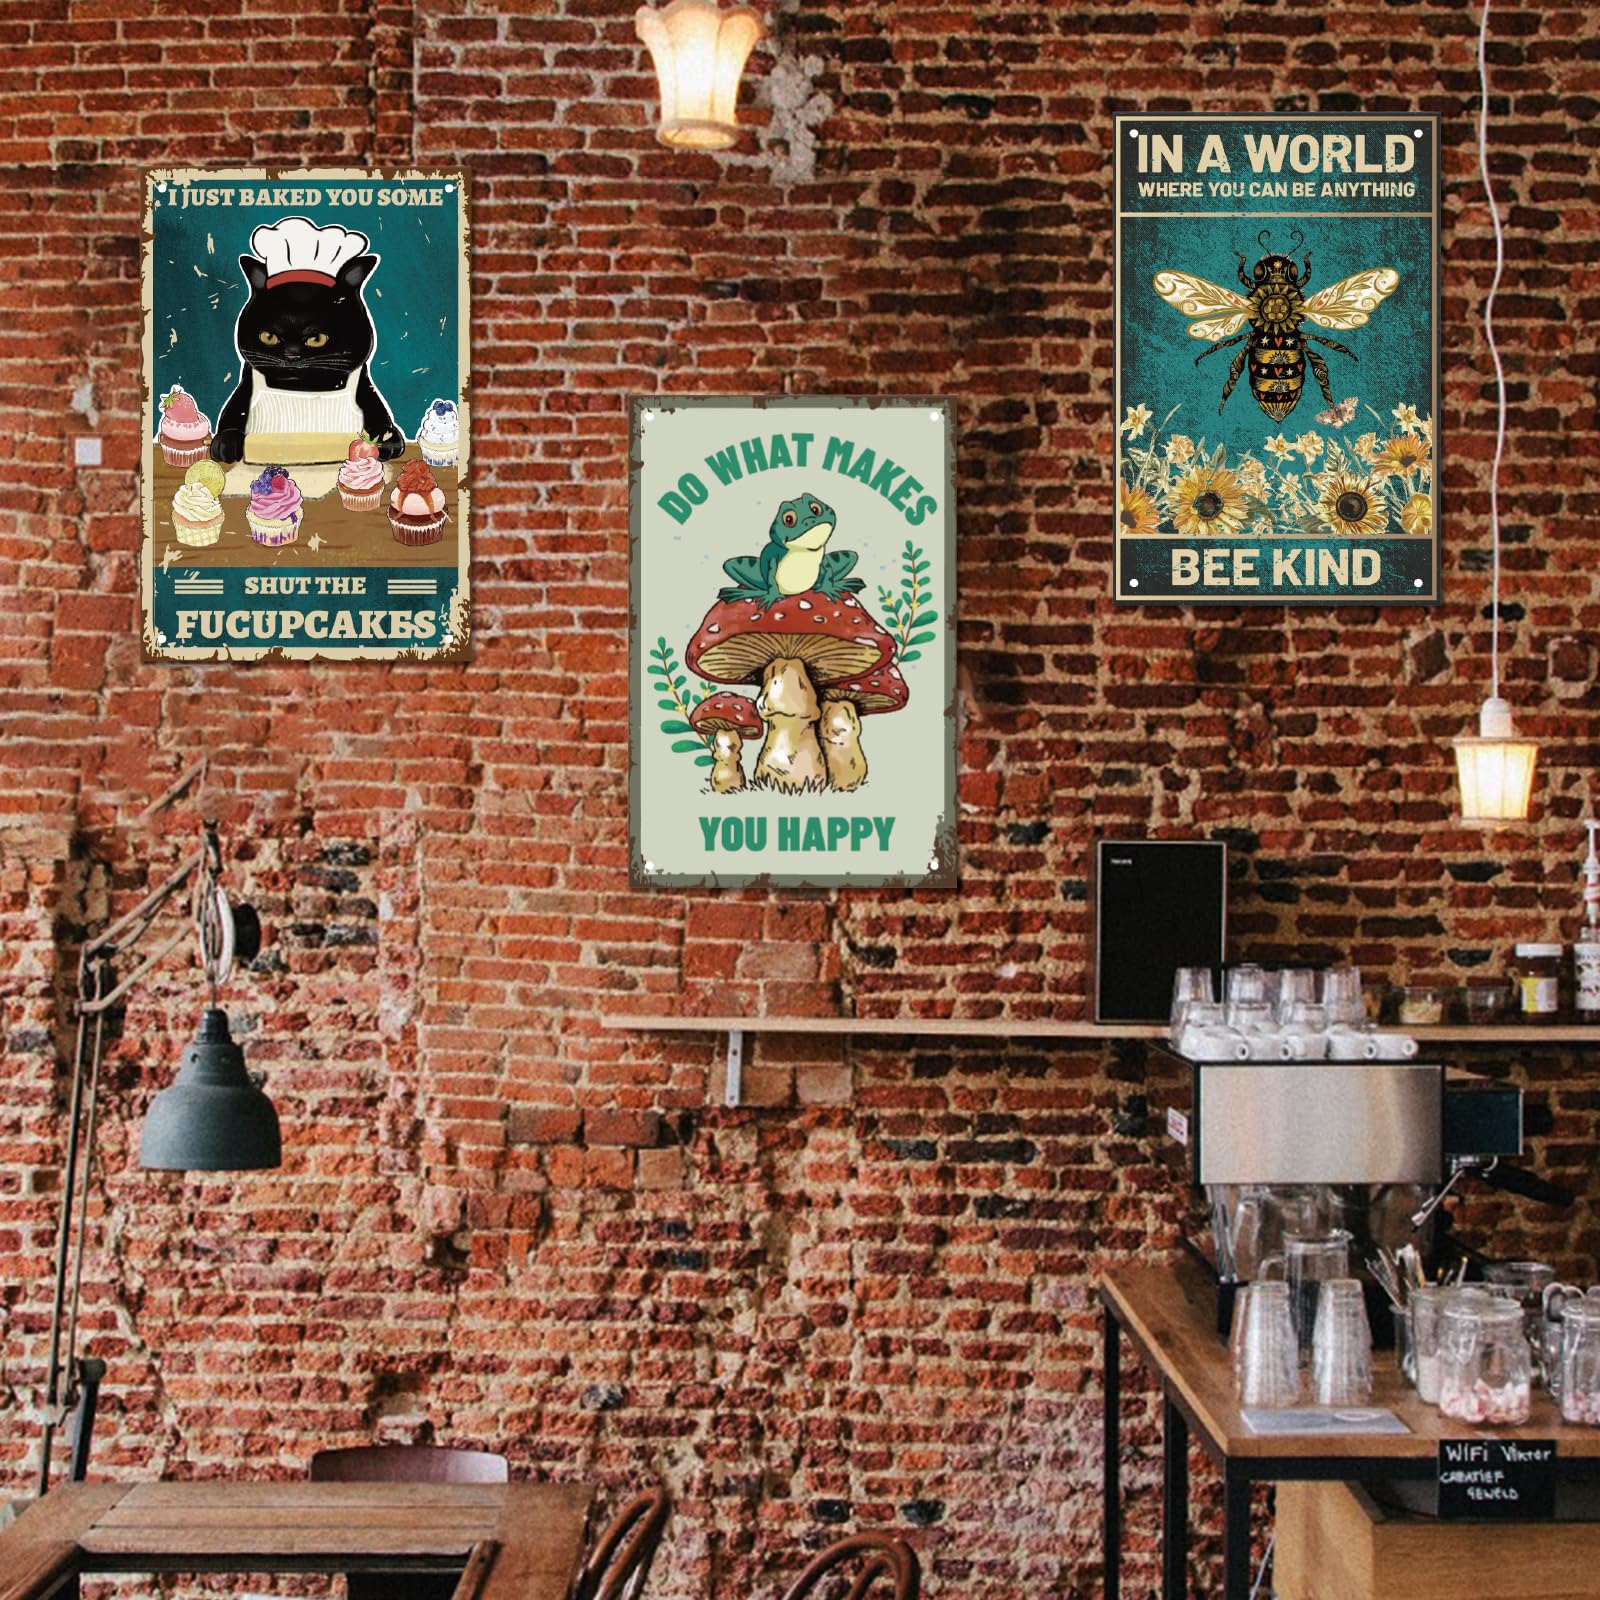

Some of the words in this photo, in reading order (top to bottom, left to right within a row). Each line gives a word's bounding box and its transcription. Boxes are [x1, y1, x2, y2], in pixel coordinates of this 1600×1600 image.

[1138, 134, 1183, 173] IN
[1196, 134, 1232, 173] A
[1244, 134, 1415, 174] WORLD
[168, 188, 177, 206] I
[181, 188, 234, 209] JUST
[239, 188, 321, 206] BAKED
[325, 188, 374, 206] YOU
[377, 187, 443, 206] SOME
[1138, 182, 1204, 197] WHERE
[1208, 182, 1245, 197] YOU
[1249, 182, 1288, 197] CAN
[1292, 182, 1316, 197] BE
[1320, 182, 1416, 198] ANYTHING
[657, 472, 709, 525] DO
[704, 432, 814, 487] WHAT
[822, 436, 937, 526] MAKES
[1171, 548, 1260, 586] BEE
[1272, 548, 1382, 586] KIND
[244, 576, 315, 595] SHUT
[316, 576, 366, 595] THE
[175, 610, 436, 640] FUCUPCAKES
[699, 816, 767, 851] YOU
[778, 816, 896, 851] HAPPY
